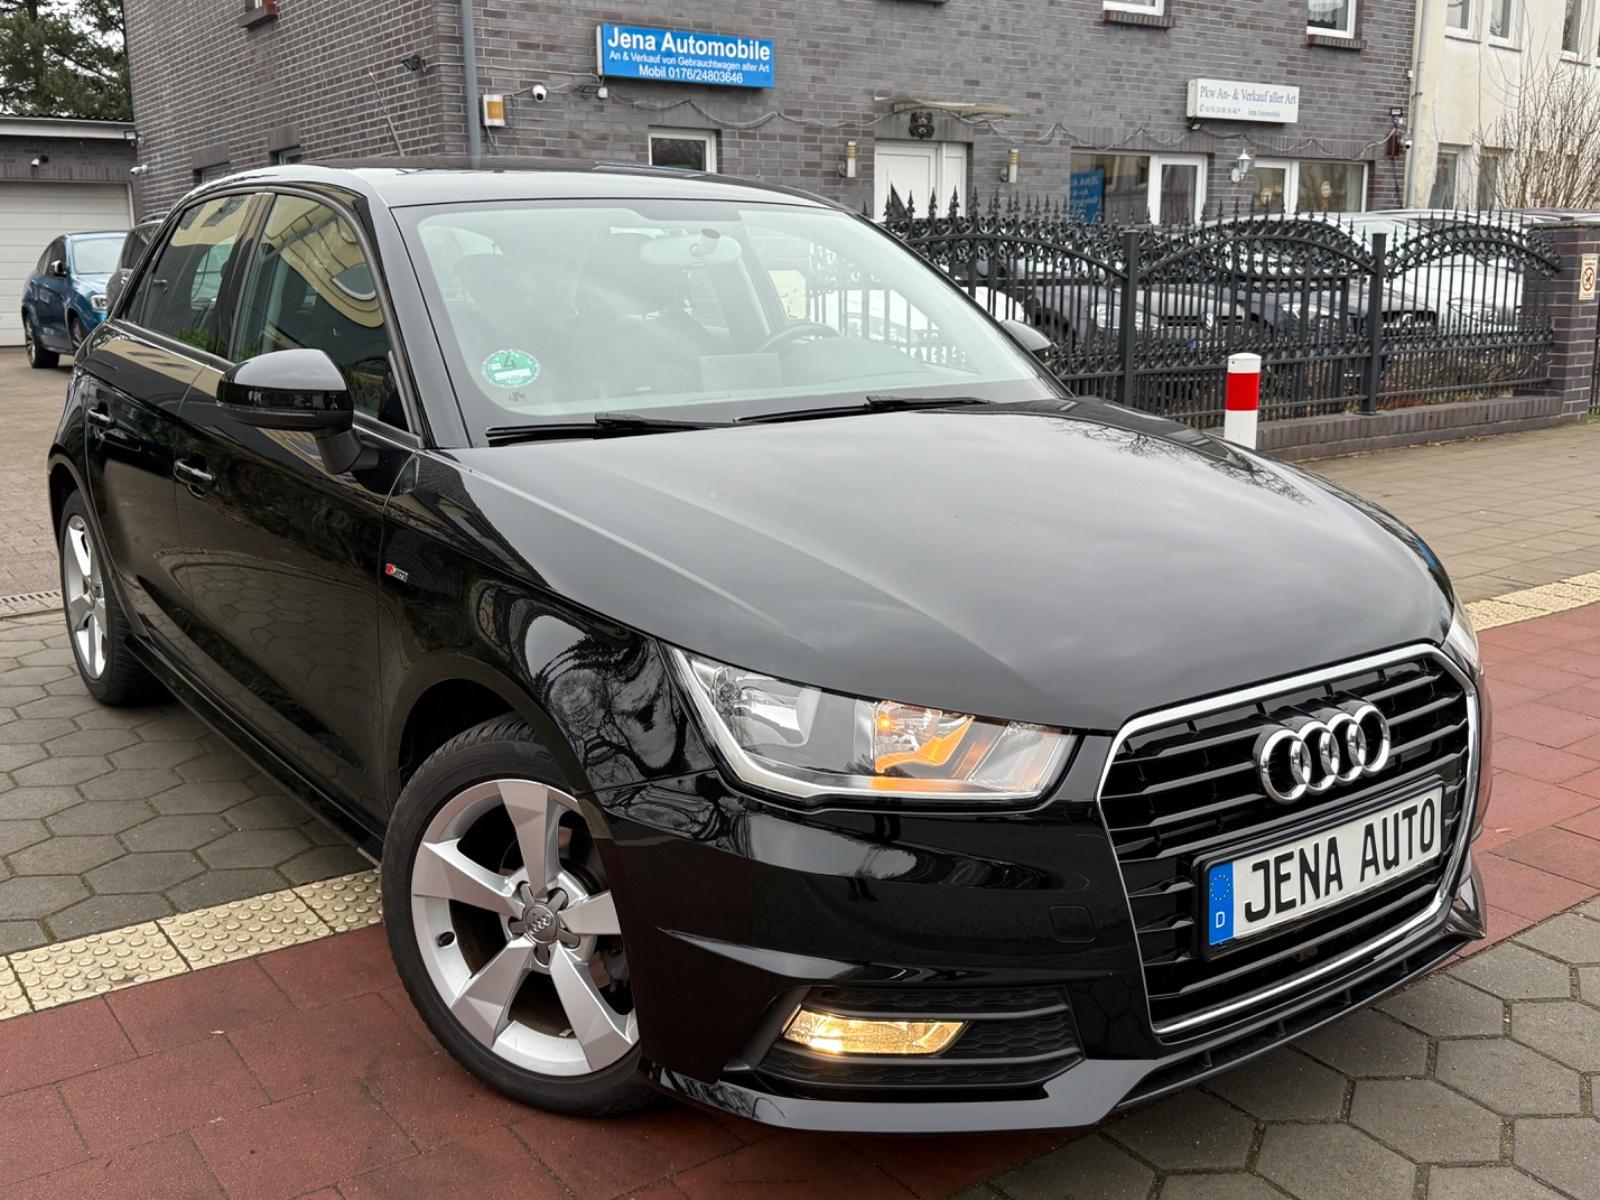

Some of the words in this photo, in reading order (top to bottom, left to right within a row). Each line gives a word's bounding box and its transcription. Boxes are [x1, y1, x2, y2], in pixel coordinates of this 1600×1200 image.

[607, 26, 656, 51] Jena
[661, 32, 770, 61] Automobile
[609, 50, 621, 60] An
[622, 51, 630, 61] &
[631, 52, 661, 64] Verkauf
[662, 57, 677, 65] von
[678, 57, 740, 71] Gebrauchtwagen
[742, 63, 758, 72] aller
[758, 63, 770, 73] Art
[639, 64, 667, 78] Mobil
[669, 67, 744, 84] 0176/24803646
[504, 354, 517, 368] 4
[1244, 836, 1343, 922] JENA
[1359, 798, 1436, 883] AUTO
[1215, 911, 1226, 929] D
